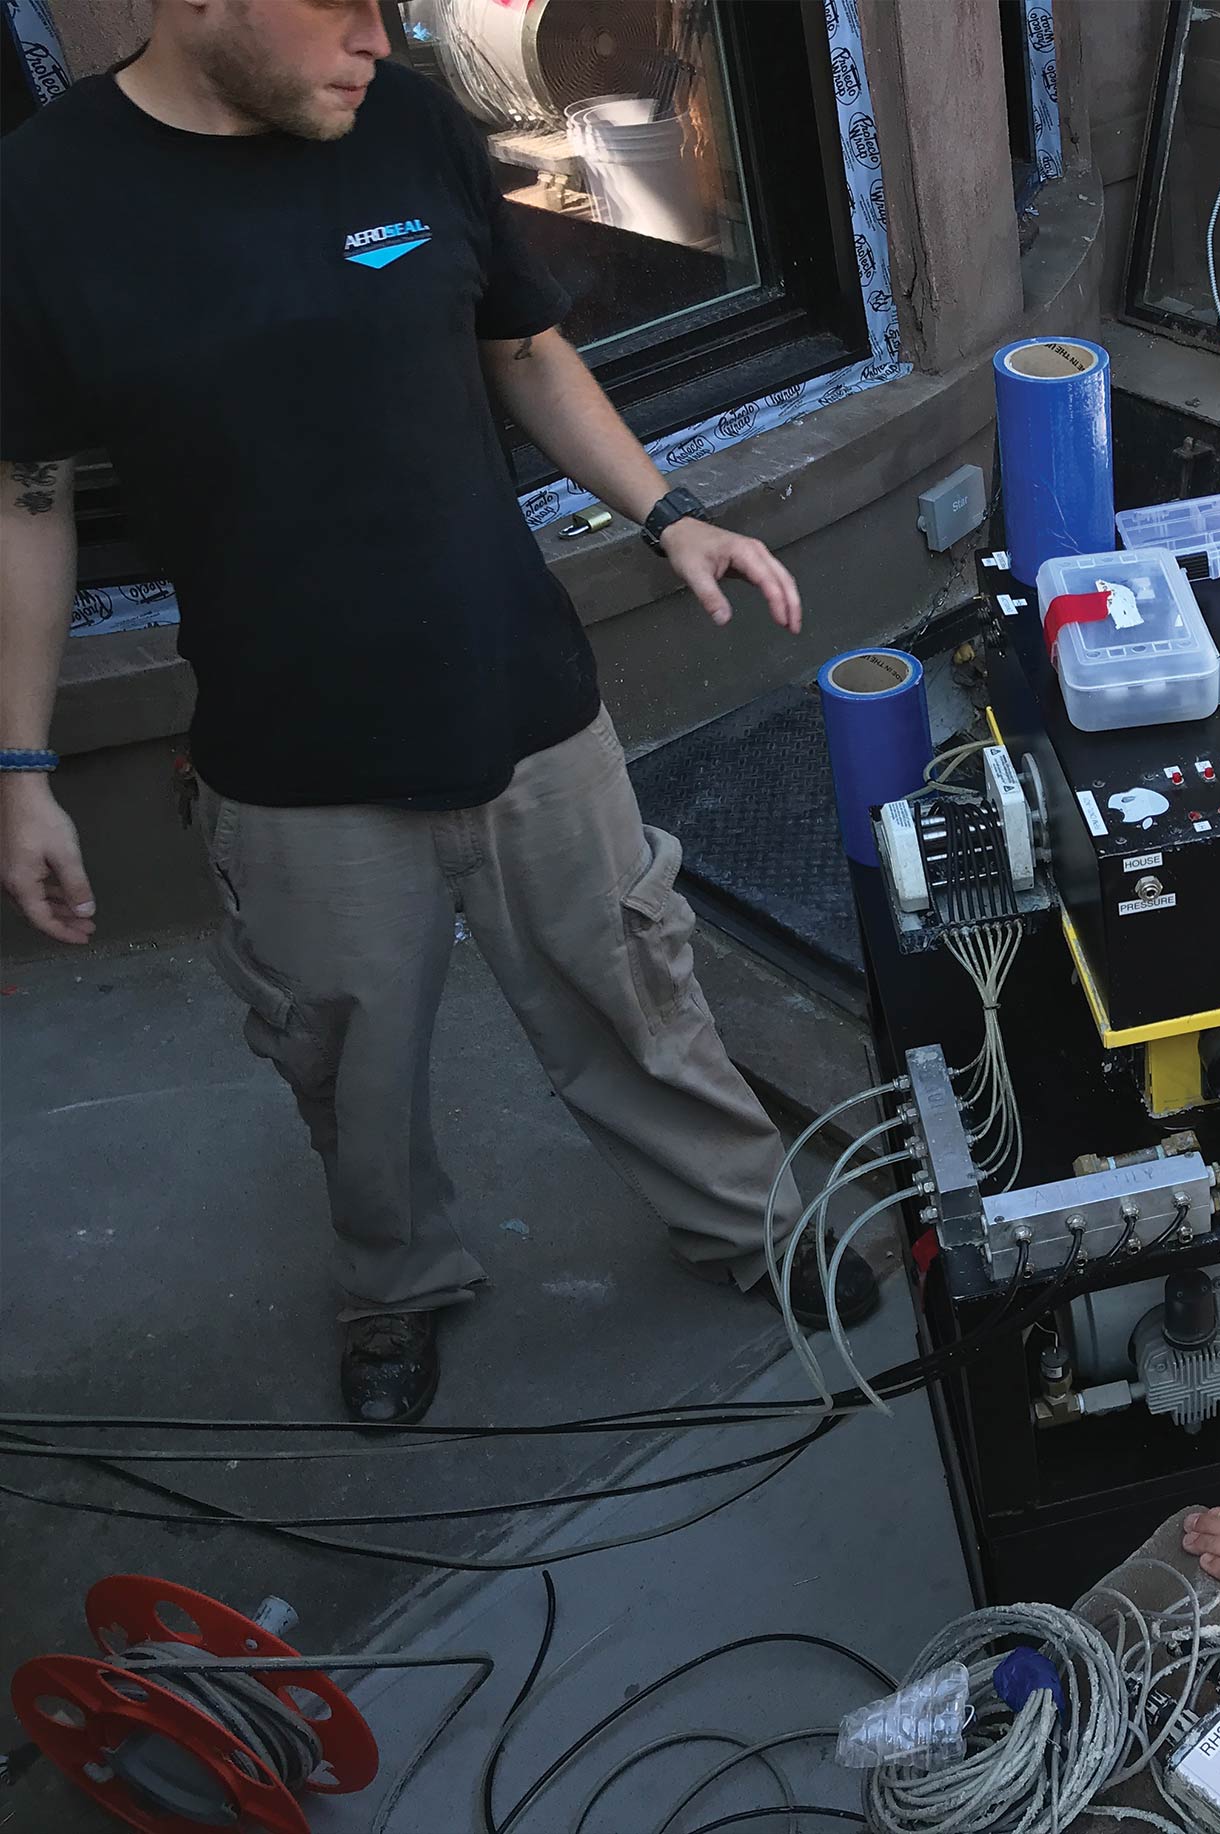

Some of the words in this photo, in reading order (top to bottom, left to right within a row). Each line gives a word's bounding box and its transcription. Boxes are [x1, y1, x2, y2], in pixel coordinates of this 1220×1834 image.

[22, 43, 70, 95] Protec
[833, 48, 862, 97] Protecto
[850, 123, 868, 159] Wrap
[853, 115, 880, 163] Protecto
[344, 219, 430, 250] AEROSEAL
[1055, 346, 1071, 360] THE
[526, 490, 553, 517] otecto
[952, 496, 969, 512] Star
[870, 656, 885, 669] THE
[1124, 855, 1161, 869] HOUSE
[1120, 895, 1174, 912] PRESSURE
